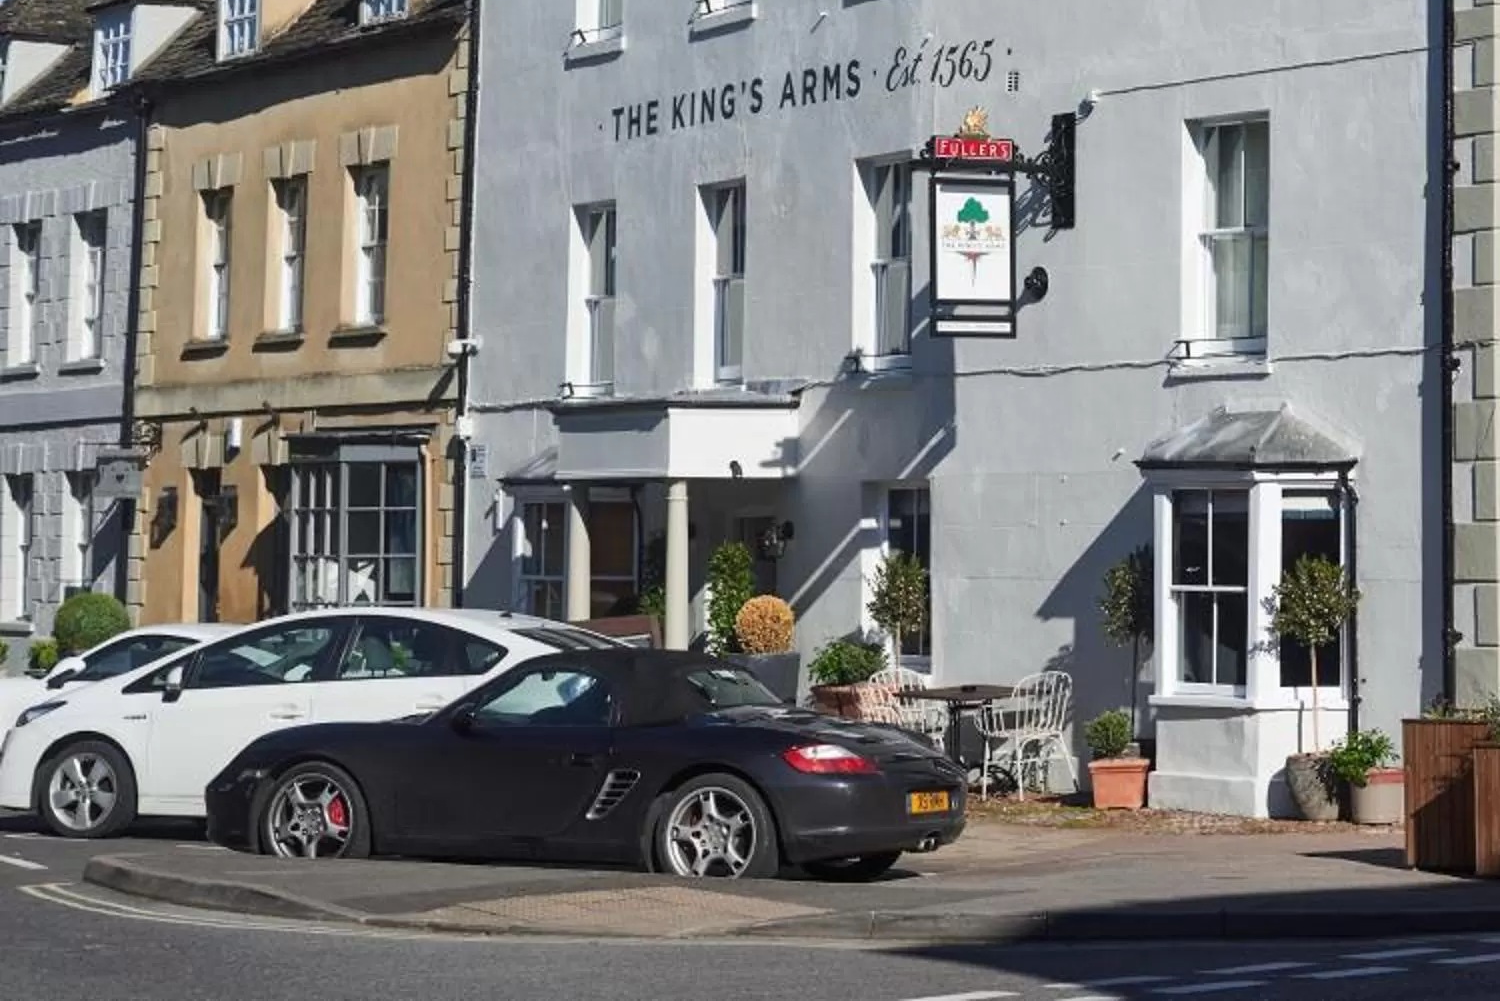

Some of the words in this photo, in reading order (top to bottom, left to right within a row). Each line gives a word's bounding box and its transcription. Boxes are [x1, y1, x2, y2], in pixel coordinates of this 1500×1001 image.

[611, 99, 659, 142] THE
[671, 77, 763, 130] KING'S
[779, 59, 861, 109] ARMS
[930, 38, 994, 88] 1565
